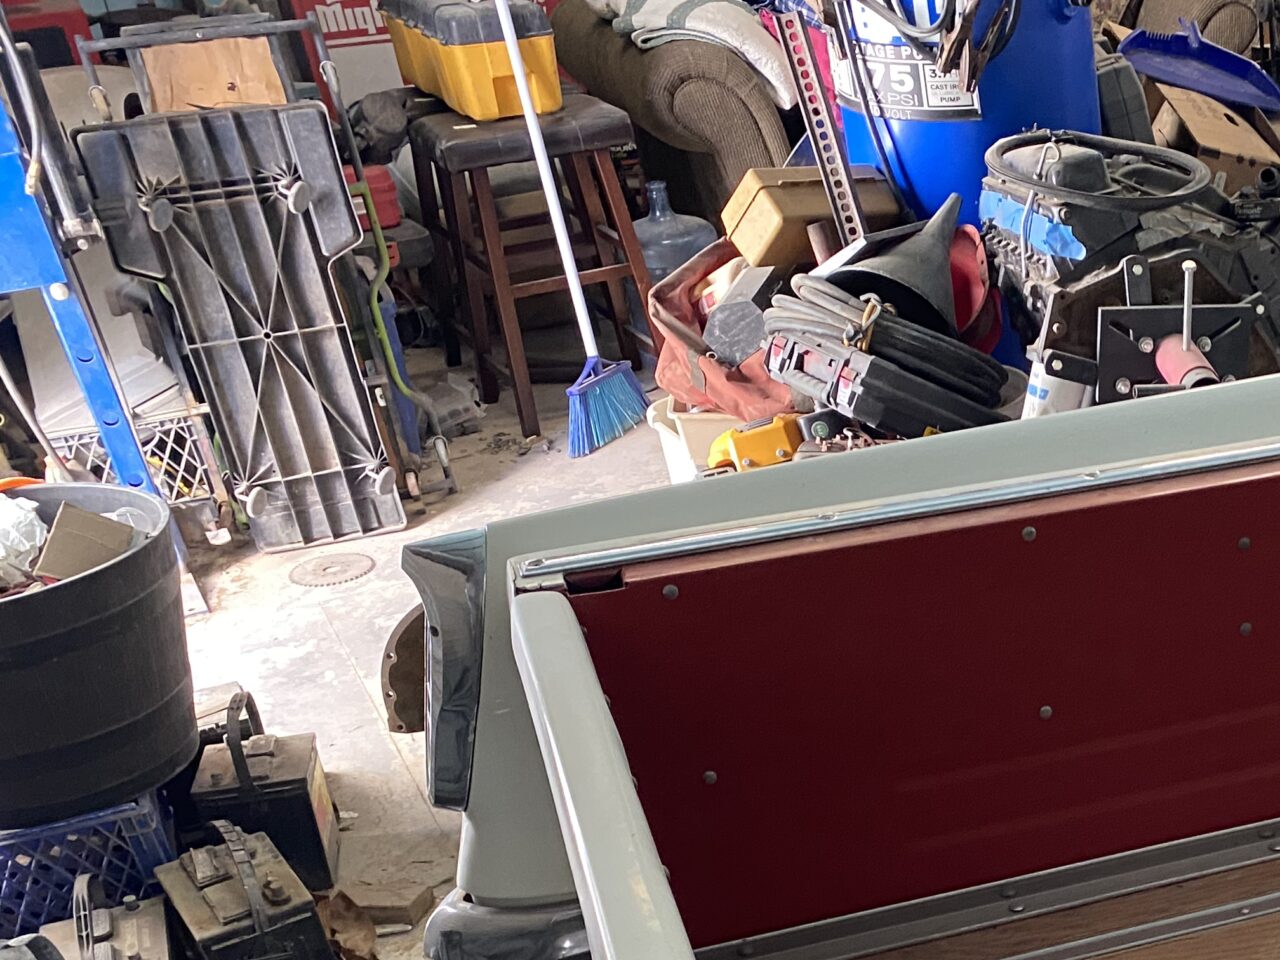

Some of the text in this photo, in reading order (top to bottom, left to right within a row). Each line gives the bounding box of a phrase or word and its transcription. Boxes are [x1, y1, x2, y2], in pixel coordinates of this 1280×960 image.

[865, 61, 915, 93] 75
[930, 83, 948, 91] CAST
[886, 92, 919, 107] PSI
